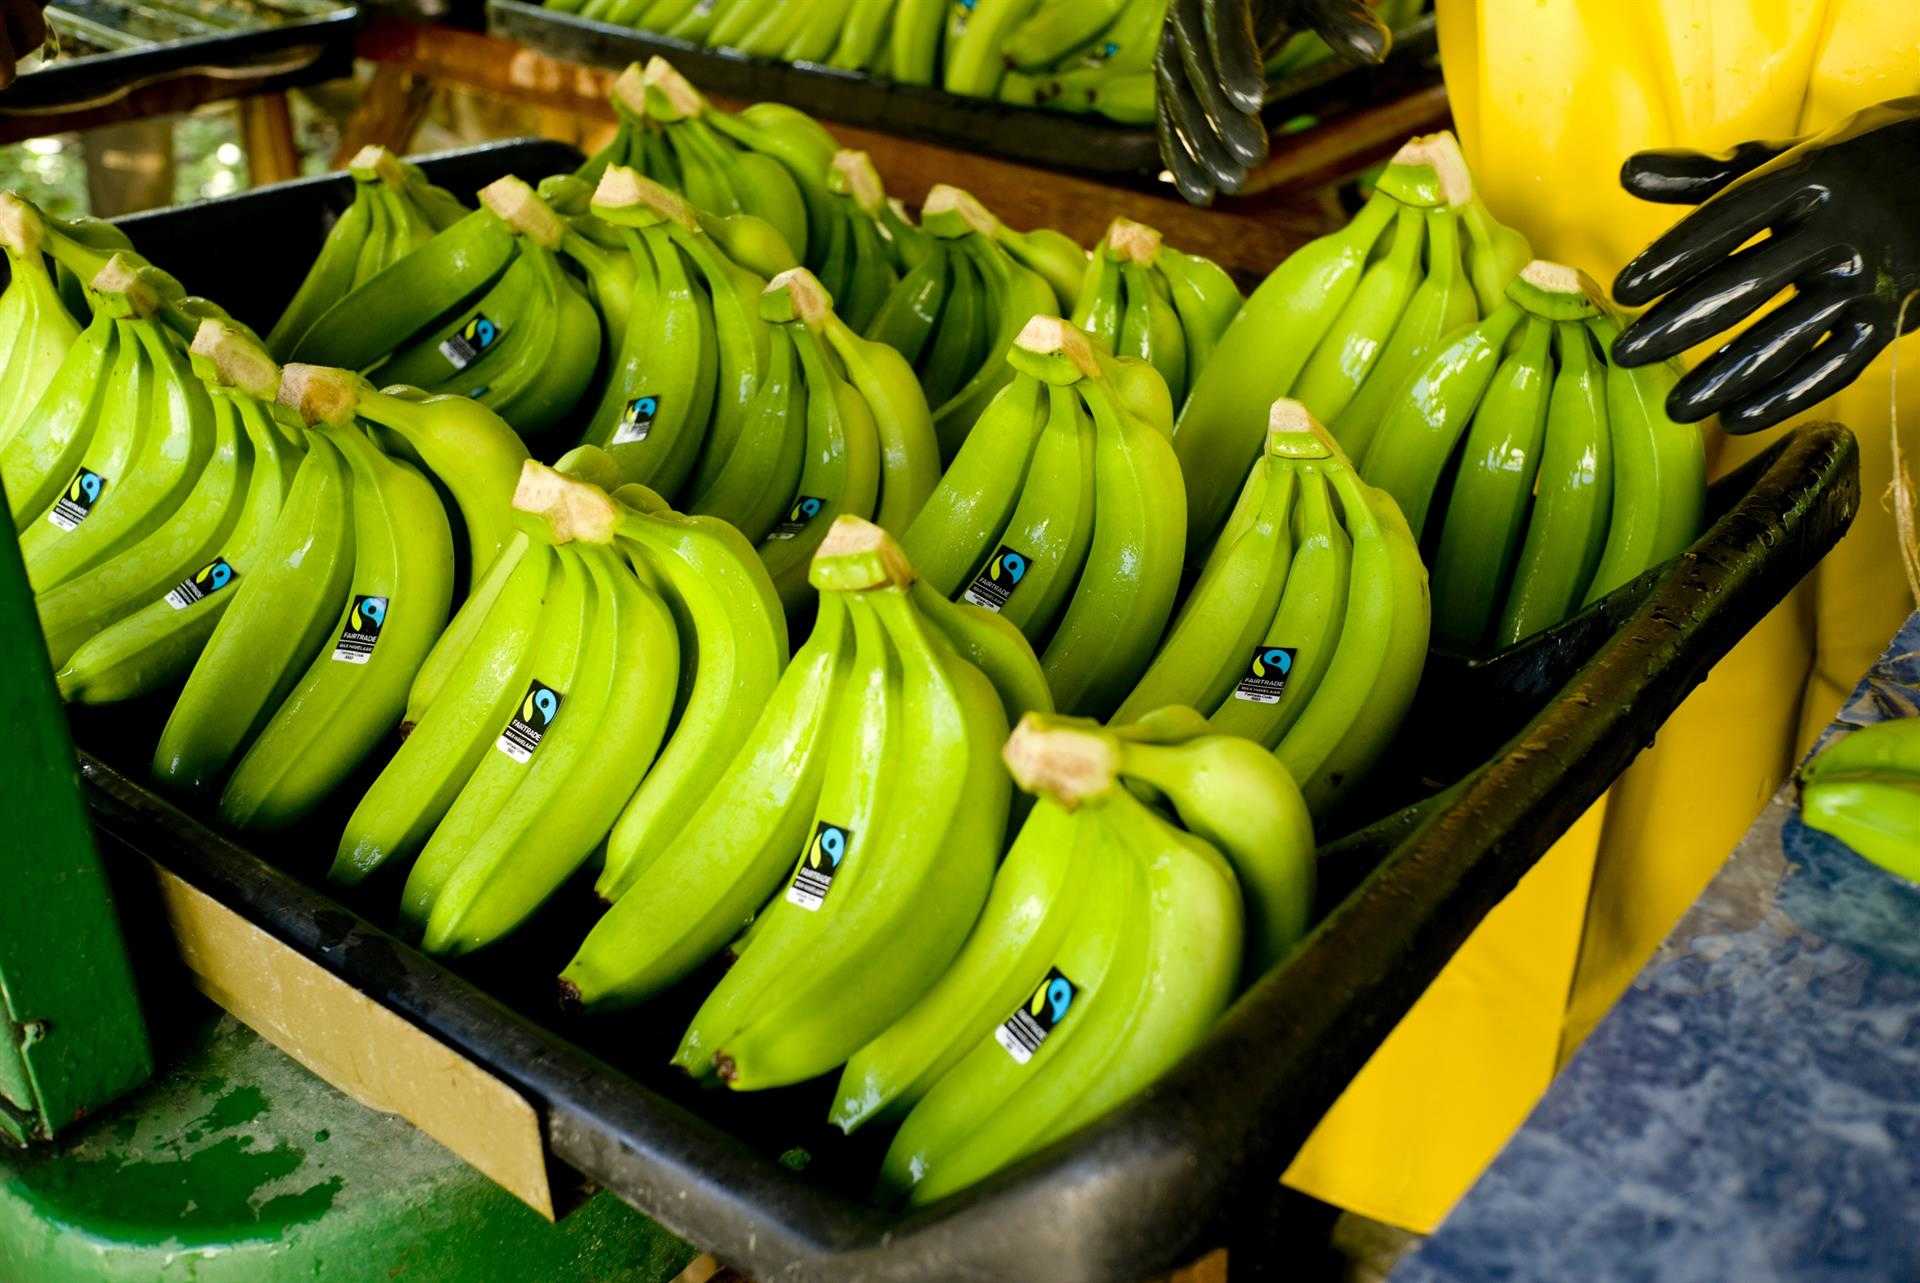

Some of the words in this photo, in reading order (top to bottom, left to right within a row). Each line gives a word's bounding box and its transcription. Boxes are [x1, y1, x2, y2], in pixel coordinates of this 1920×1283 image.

[978, 577, 1011, 597] FAIRTRADE
[343, 632, 377, 642] FAIRTRADE
[1244, 677, 1285, 687] FAIRTRADE
[511, 719, 542, 741] FAIRTRADE
